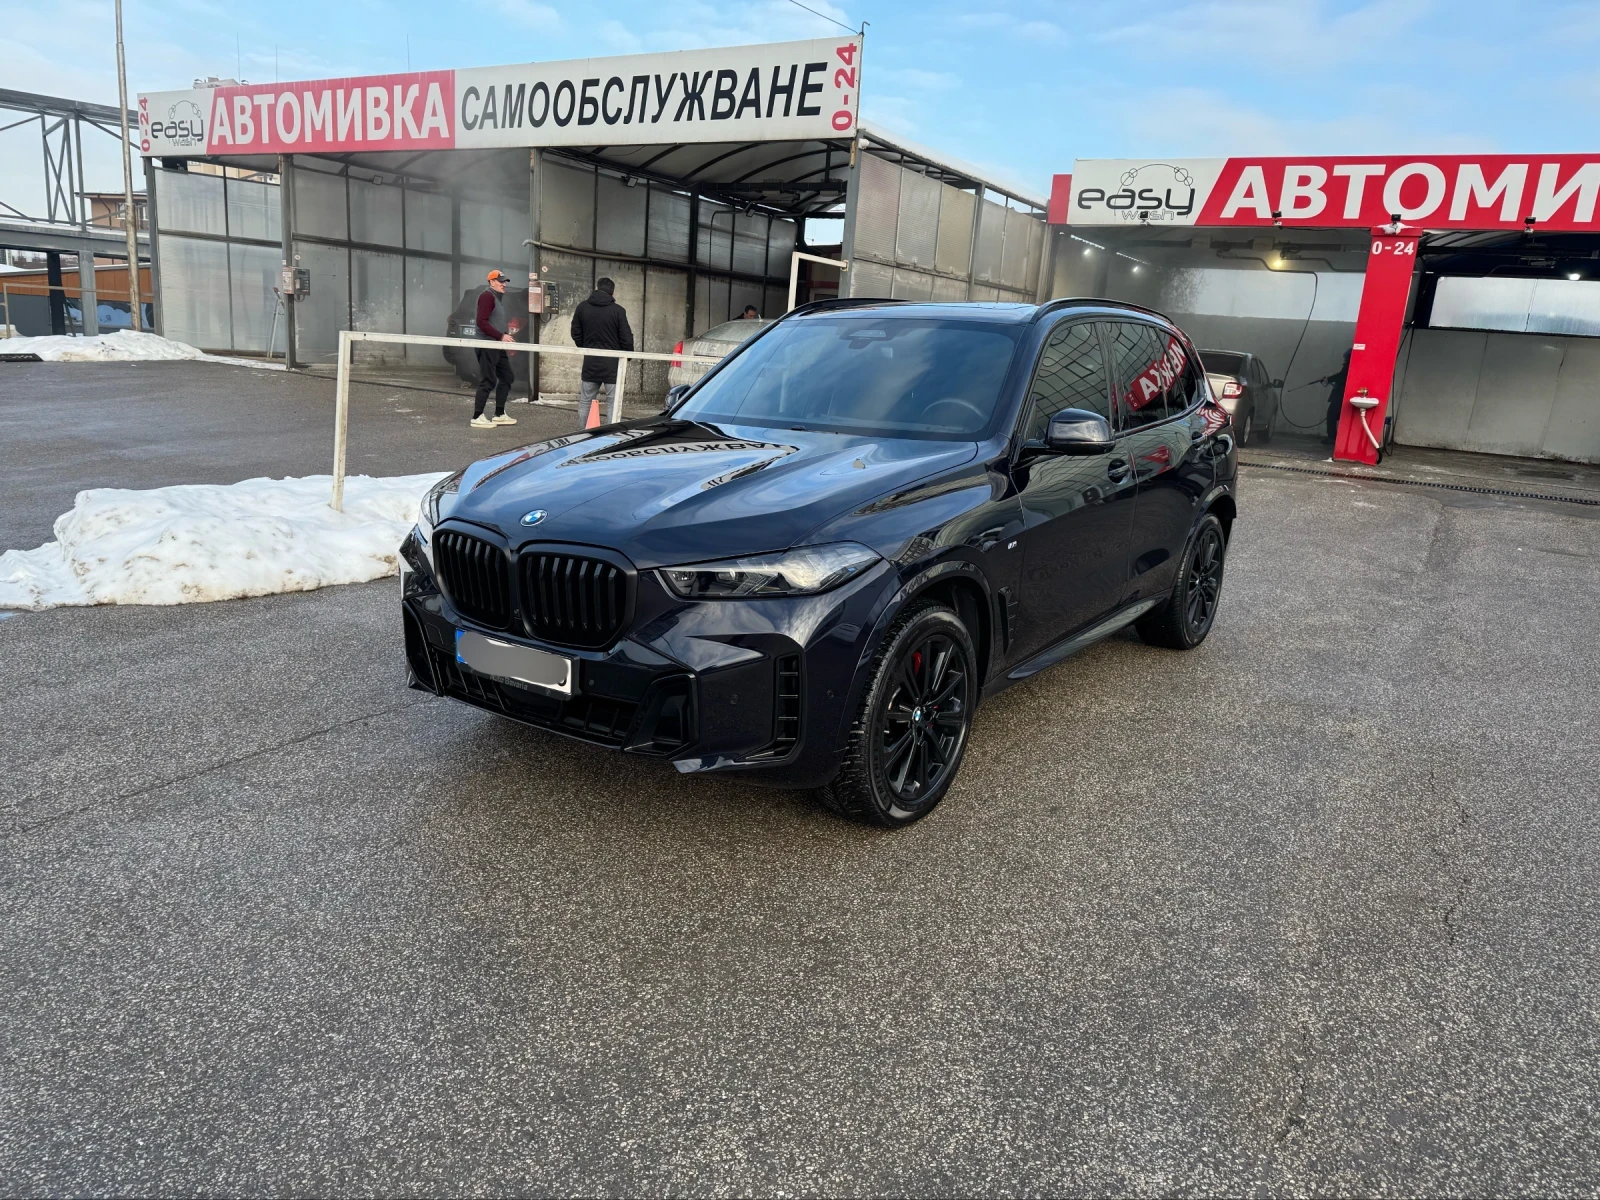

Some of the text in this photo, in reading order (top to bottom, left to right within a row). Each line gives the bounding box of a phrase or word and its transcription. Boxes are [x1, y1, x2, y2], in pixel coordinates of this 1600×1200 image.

[211, 61, 828, 145] АВТОМИВКА САМООБСЛУЖВАНЕ
[151, 119, 204, 142] easy
[1077, 187, 1195, 216] easy
[1219, 162, 1600, 223] АВТОМИ
[1121, 208, 1175, 221] wsh
[504, 676, 528, 691] Bavaria
